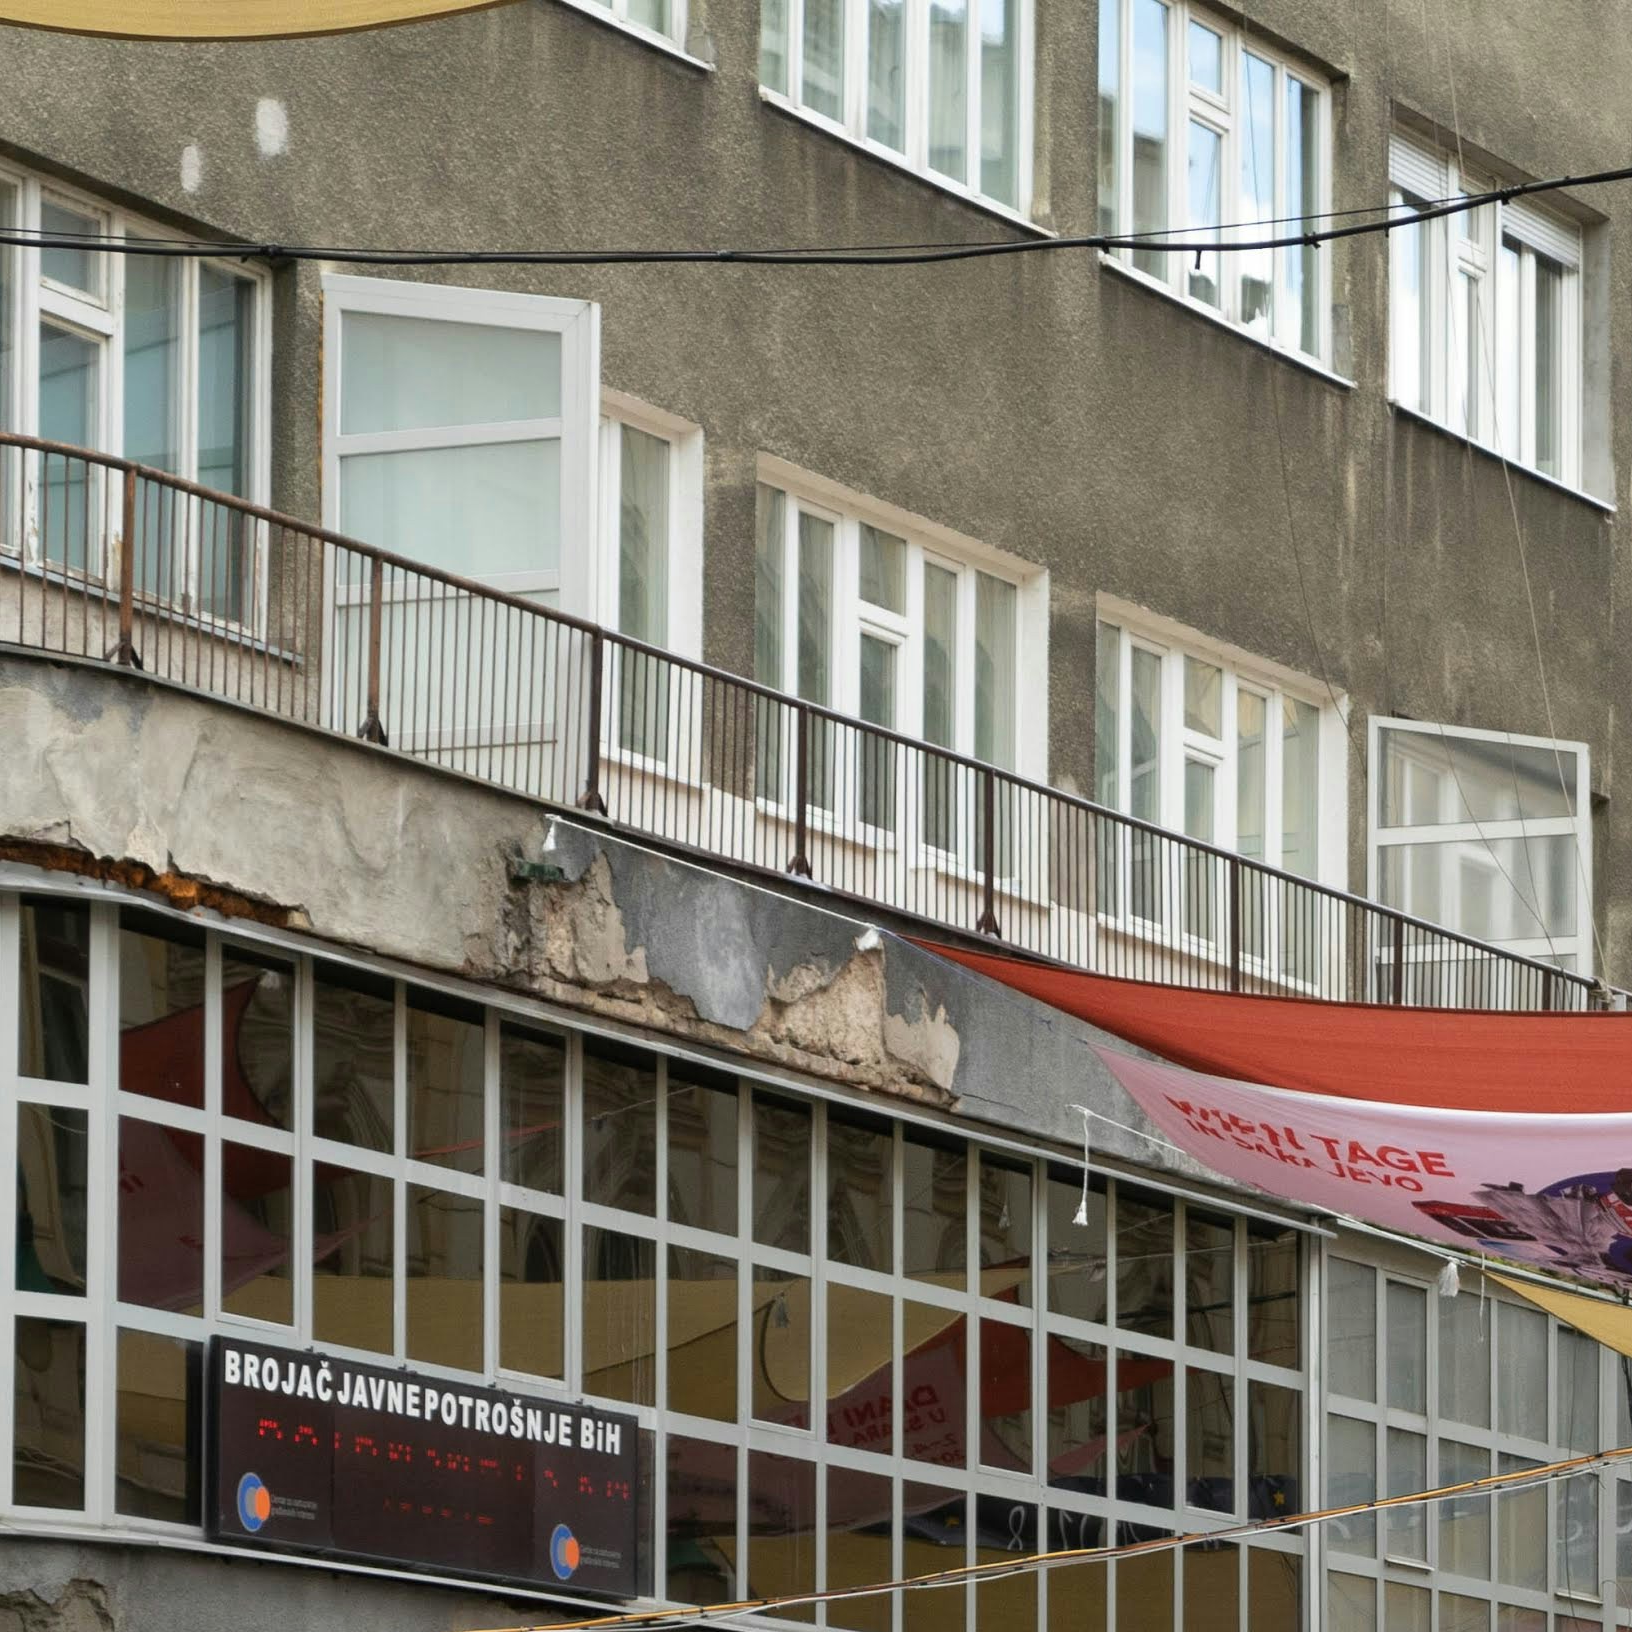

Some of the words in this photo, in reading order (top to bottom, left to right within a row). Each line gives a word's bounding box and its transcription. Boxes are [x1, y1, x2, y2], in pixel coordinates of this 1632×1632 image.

[1309, 1134, 1456, 1178] TAGE
[224, 1349, 334, 1403] BROJAČ
[336, 1371, 421, 1418] JAVNE
[424, 1387, 573, 1447] POTROŠNJE
[579, 1416, 621, 1456] BiH
